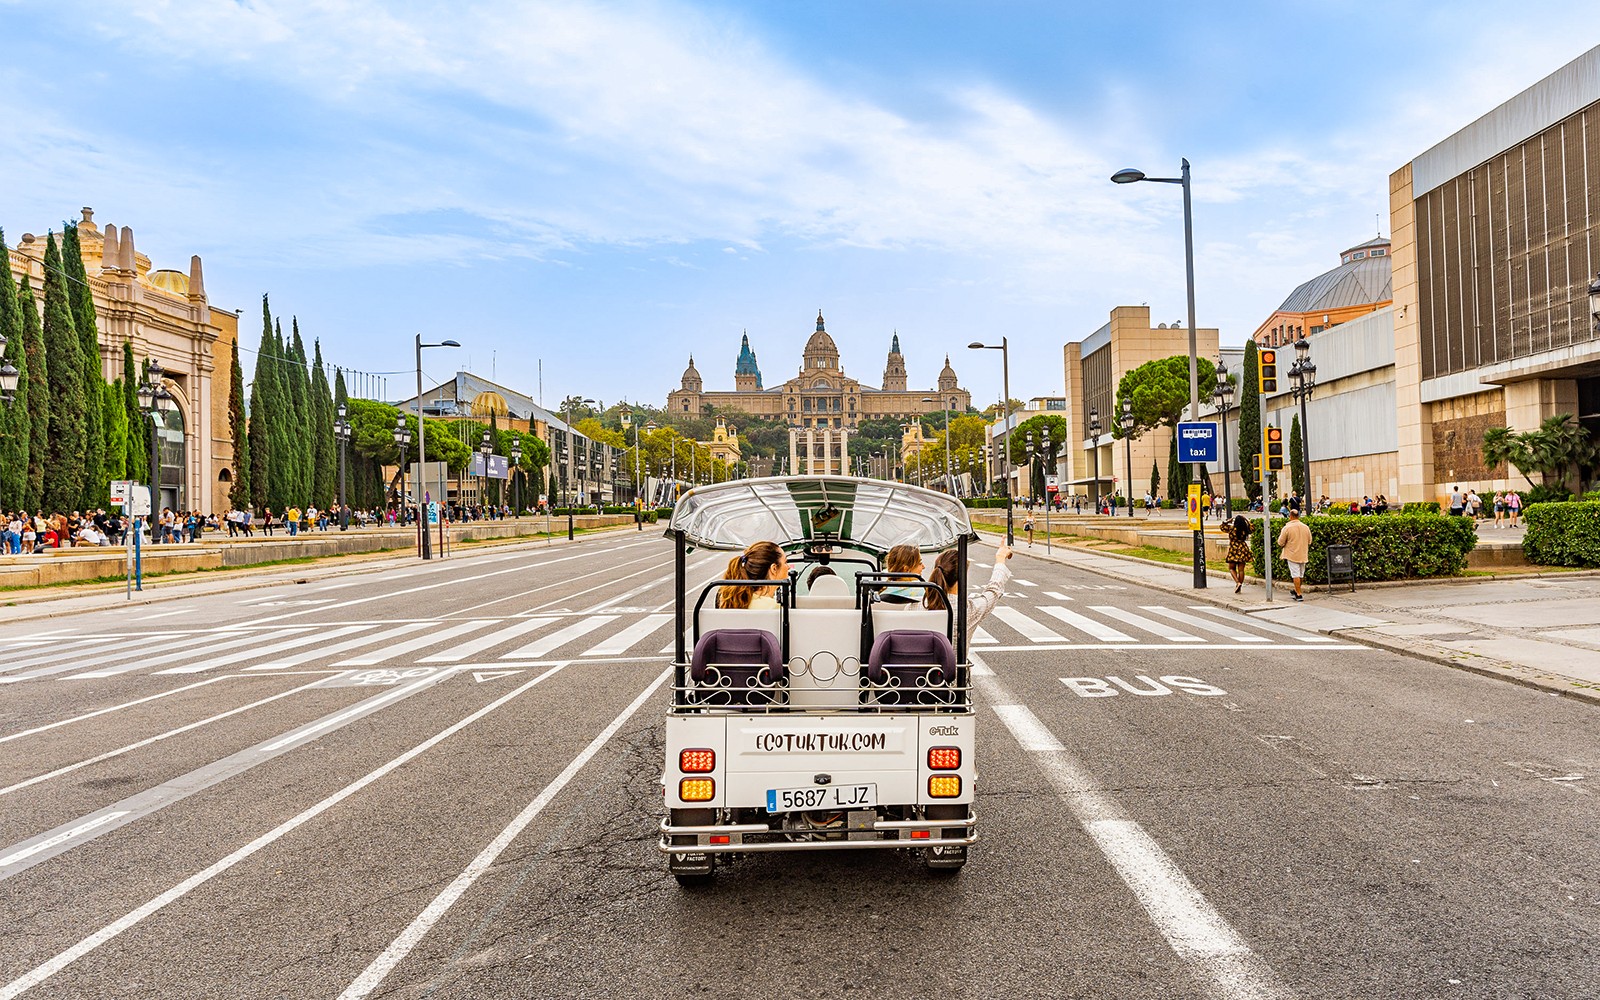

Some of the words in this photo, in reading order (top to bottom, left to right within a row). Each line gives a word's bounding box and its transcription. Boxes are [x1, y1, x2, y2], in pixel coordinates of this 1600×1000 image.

[1190, 447, 1207, 457] taxi
[1058, 675, 1229, 698] BUS
[756, 732, 886, 752] ECOTUKTUK.COM
[782, 788, 828, 808] 5687
[835, 786, 869, 806] LJZ
